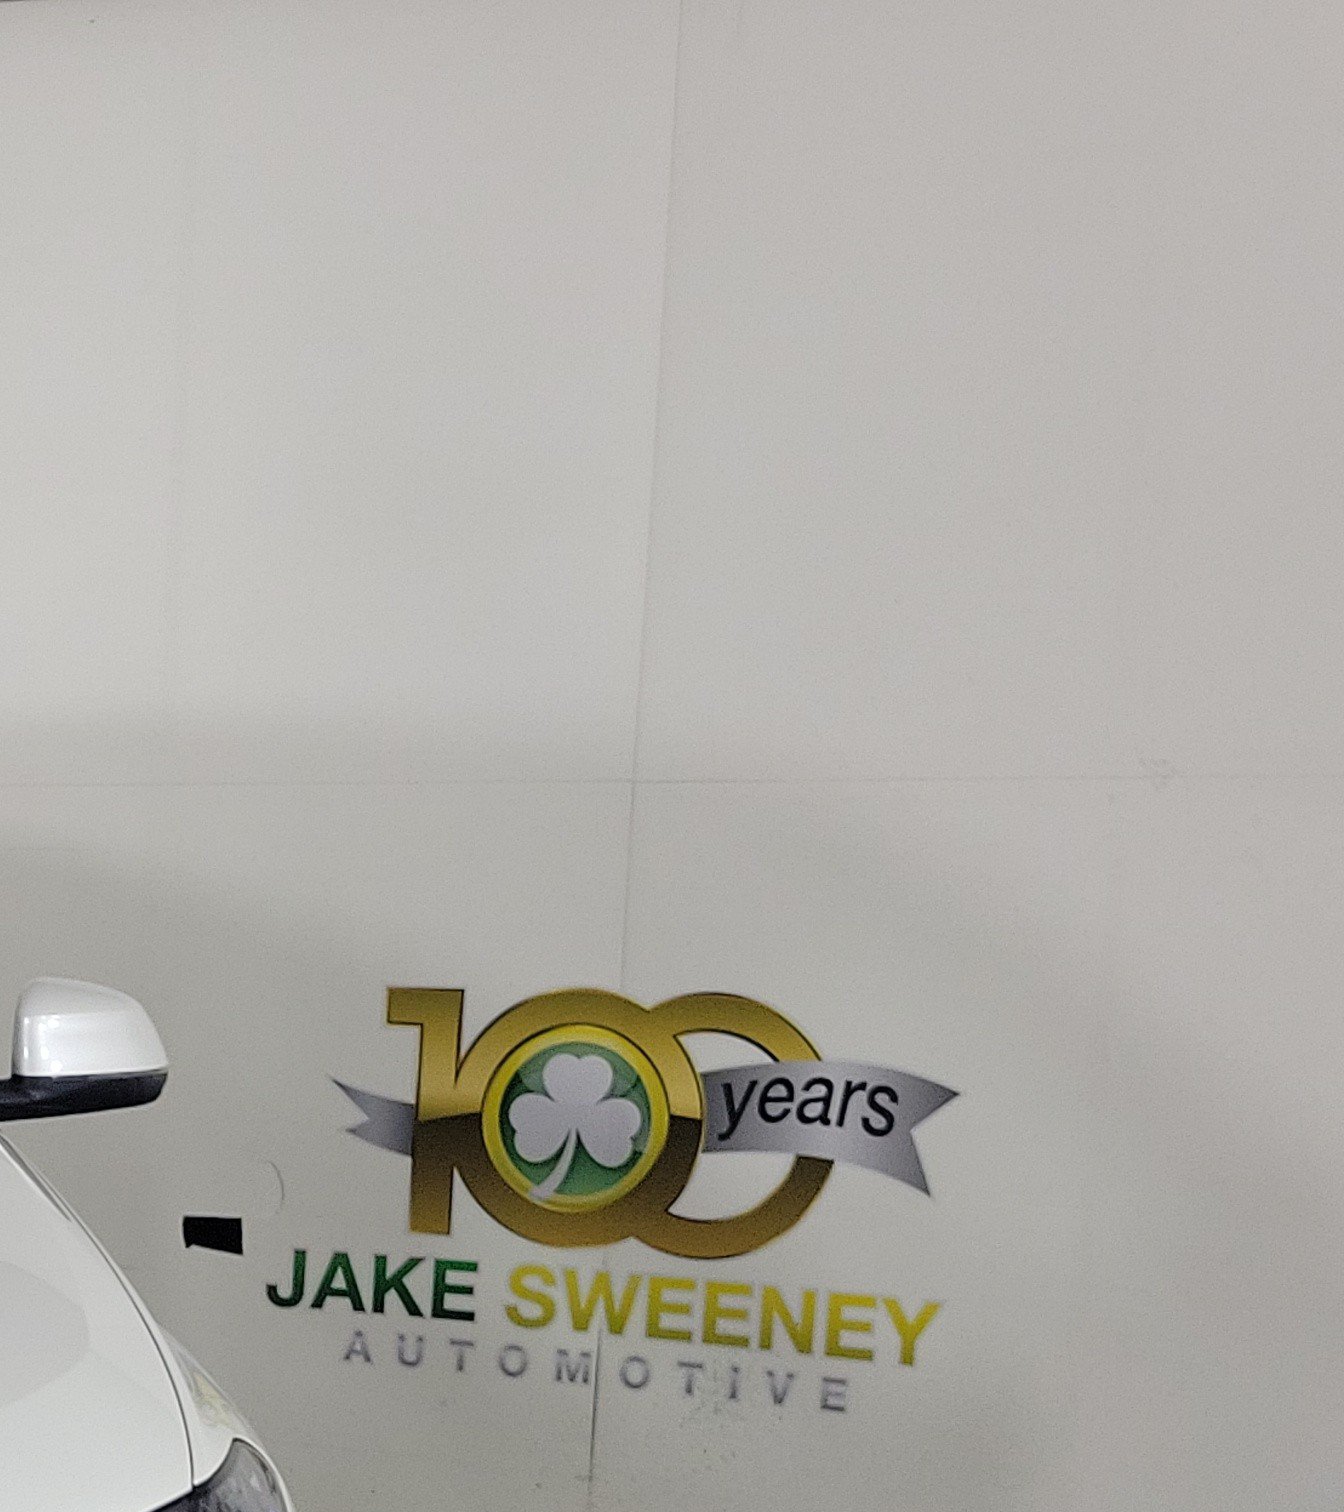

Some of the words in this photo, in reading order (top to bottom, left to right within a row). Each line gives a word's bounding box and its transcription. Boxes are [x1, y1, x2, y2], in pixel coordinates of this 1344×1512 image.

[386, 986, 834, 1259] 100
[714, 1071, 900, 1141] years
[265, 1249, 480, 1323] JAKE
[504, 1265, 942, 1367] SWEENEY
[342, 1329, 850, 1413] AUTOMOTIVE
